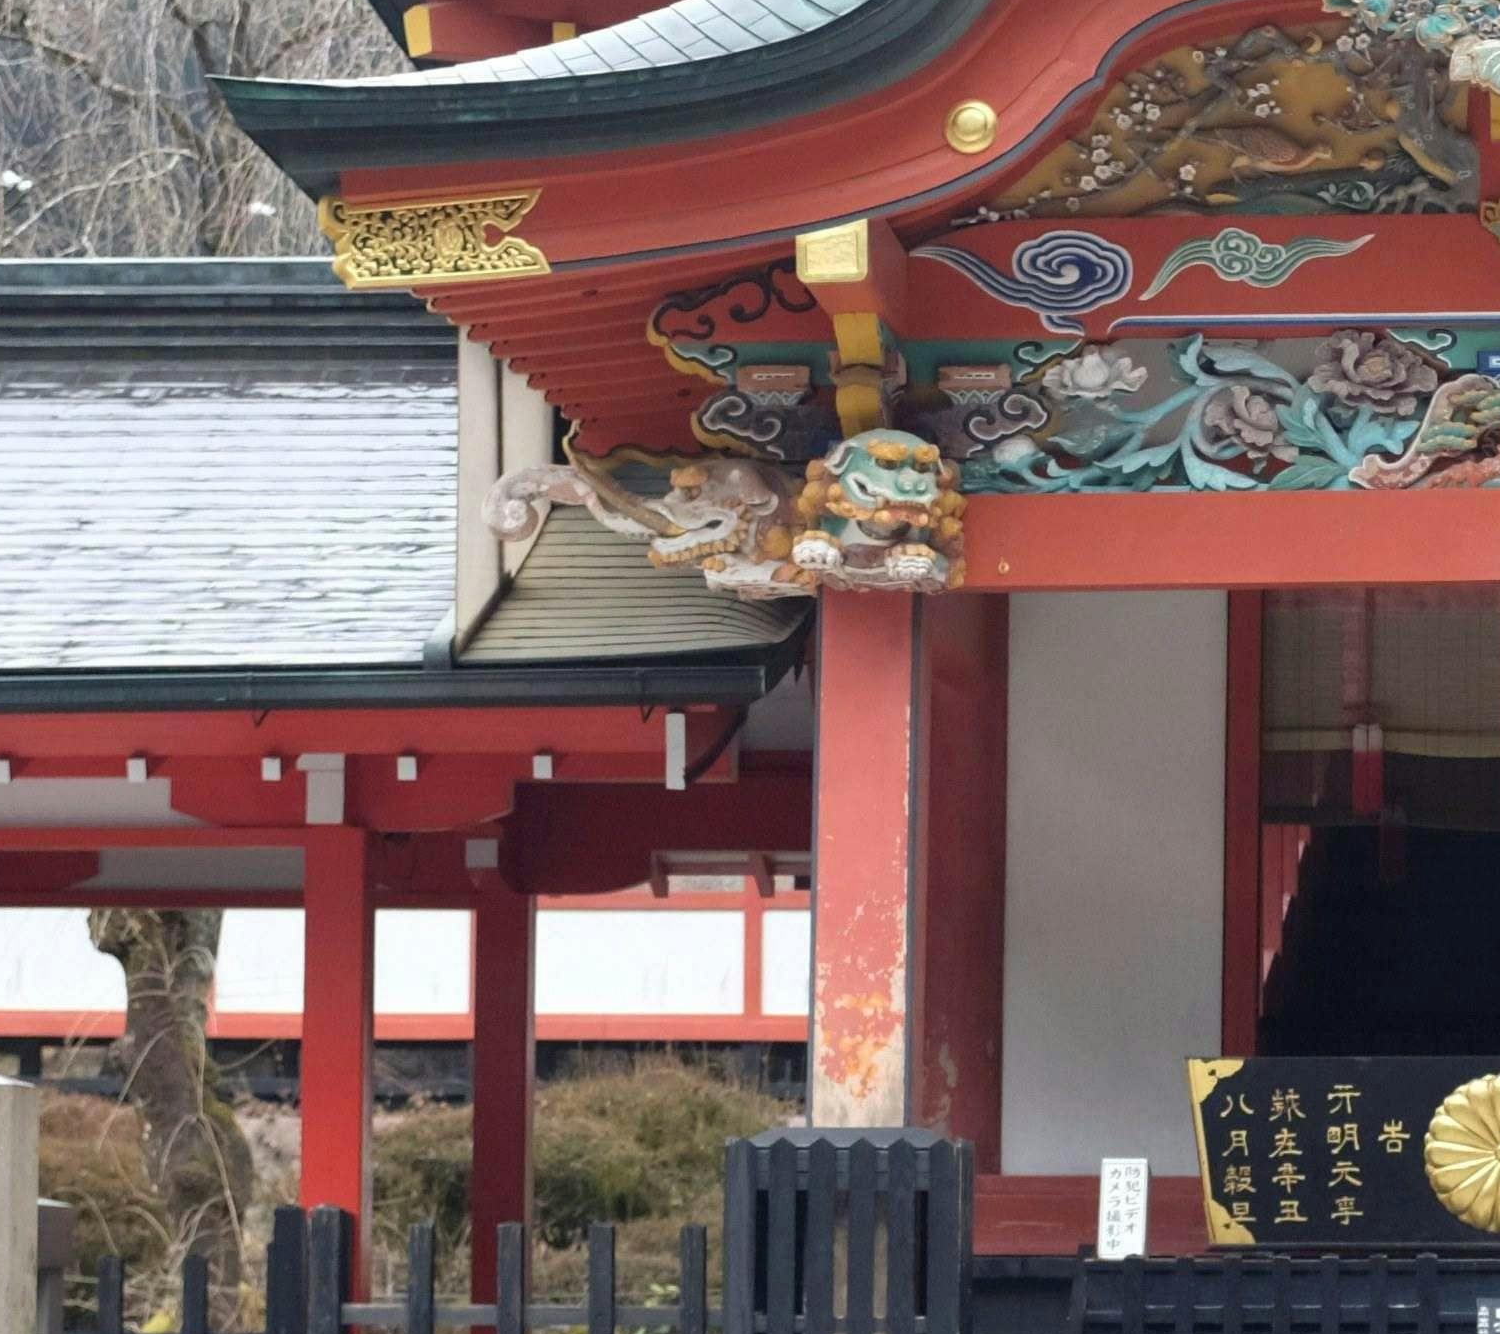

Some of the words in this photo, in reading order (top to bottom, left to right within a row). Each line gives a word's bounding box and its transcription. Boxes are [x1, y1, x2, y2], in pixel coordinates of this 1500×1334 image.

[1124, 1165, 1141, 1235] 防犯ビデオ
